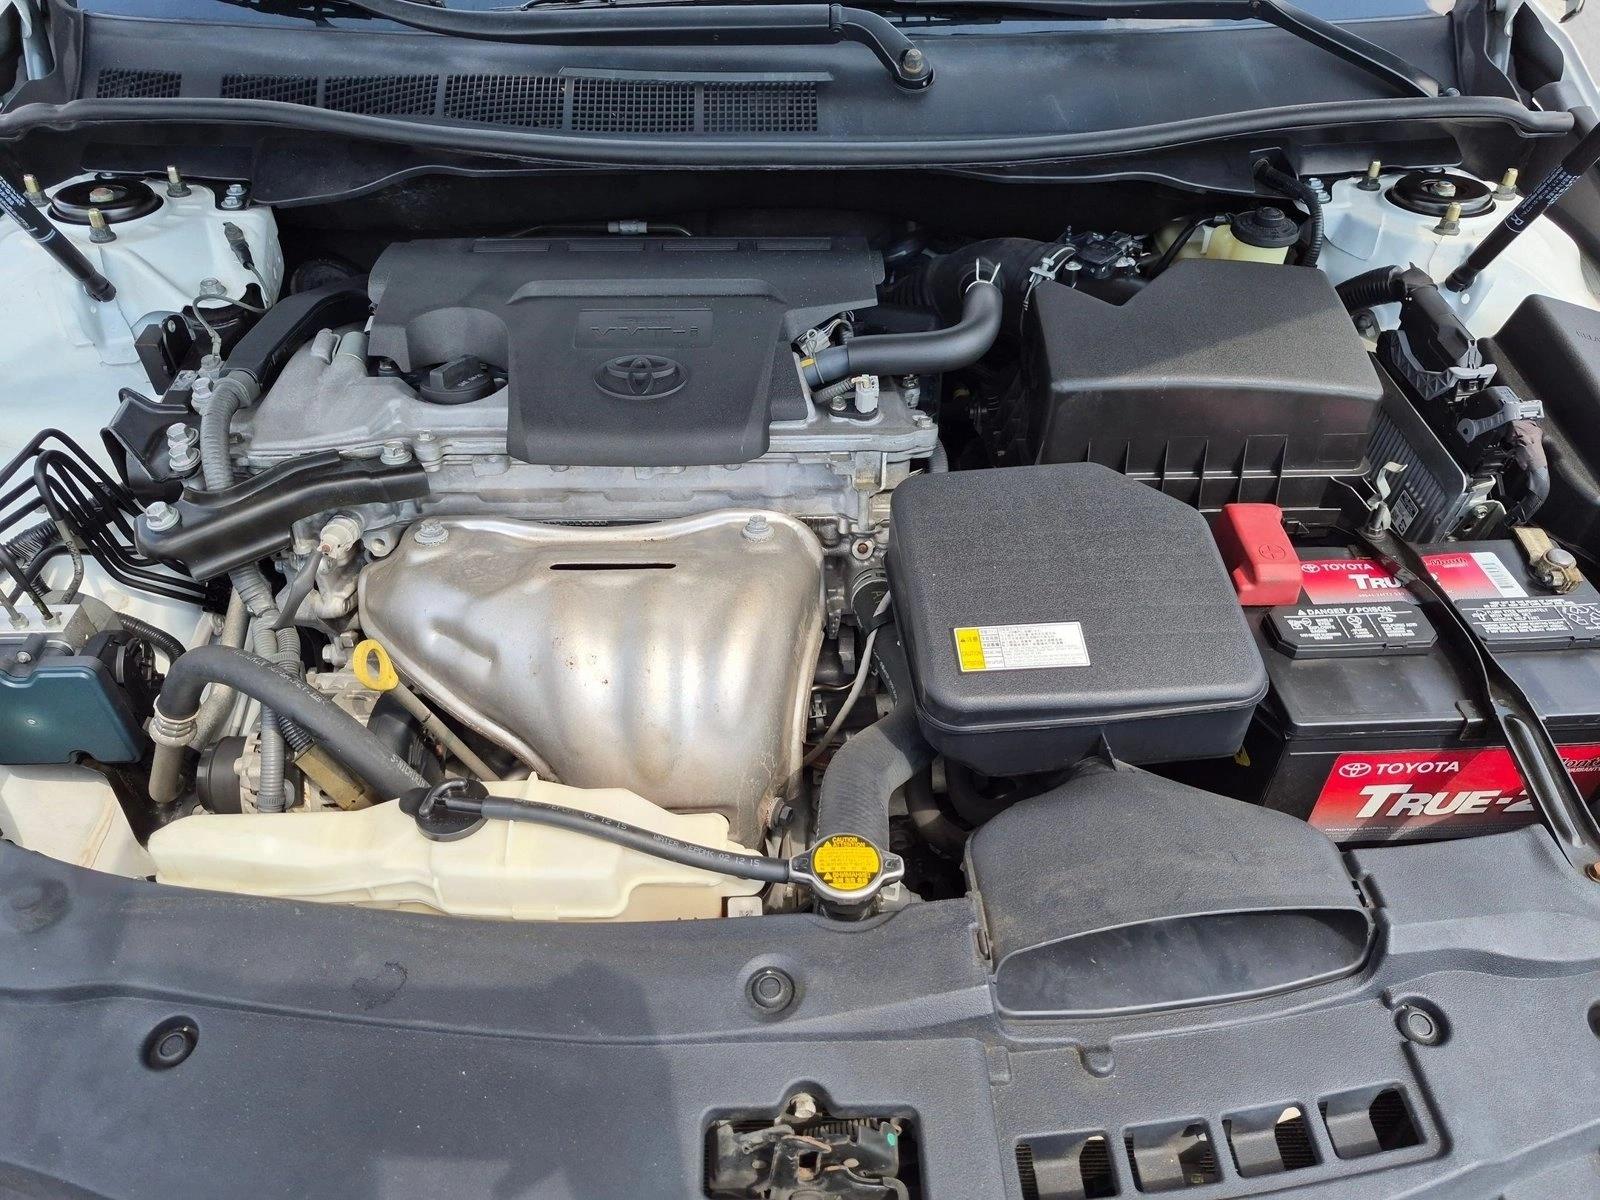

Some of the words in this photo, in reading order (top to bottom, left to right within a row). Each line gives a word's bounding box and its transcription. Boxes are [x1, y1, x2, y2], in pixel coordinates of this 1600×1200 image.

[1321, 563, 1374, 572] TOYOTA
[1348, 573, 1401, 590] TRU
[1307, 607, 1347, 616] DANGER
[1357, 605, 1392, 613] POISON
[1375, 761, 1459, 775] TOYOTA
[1355, 784, 1535, 818] TRUE-2
